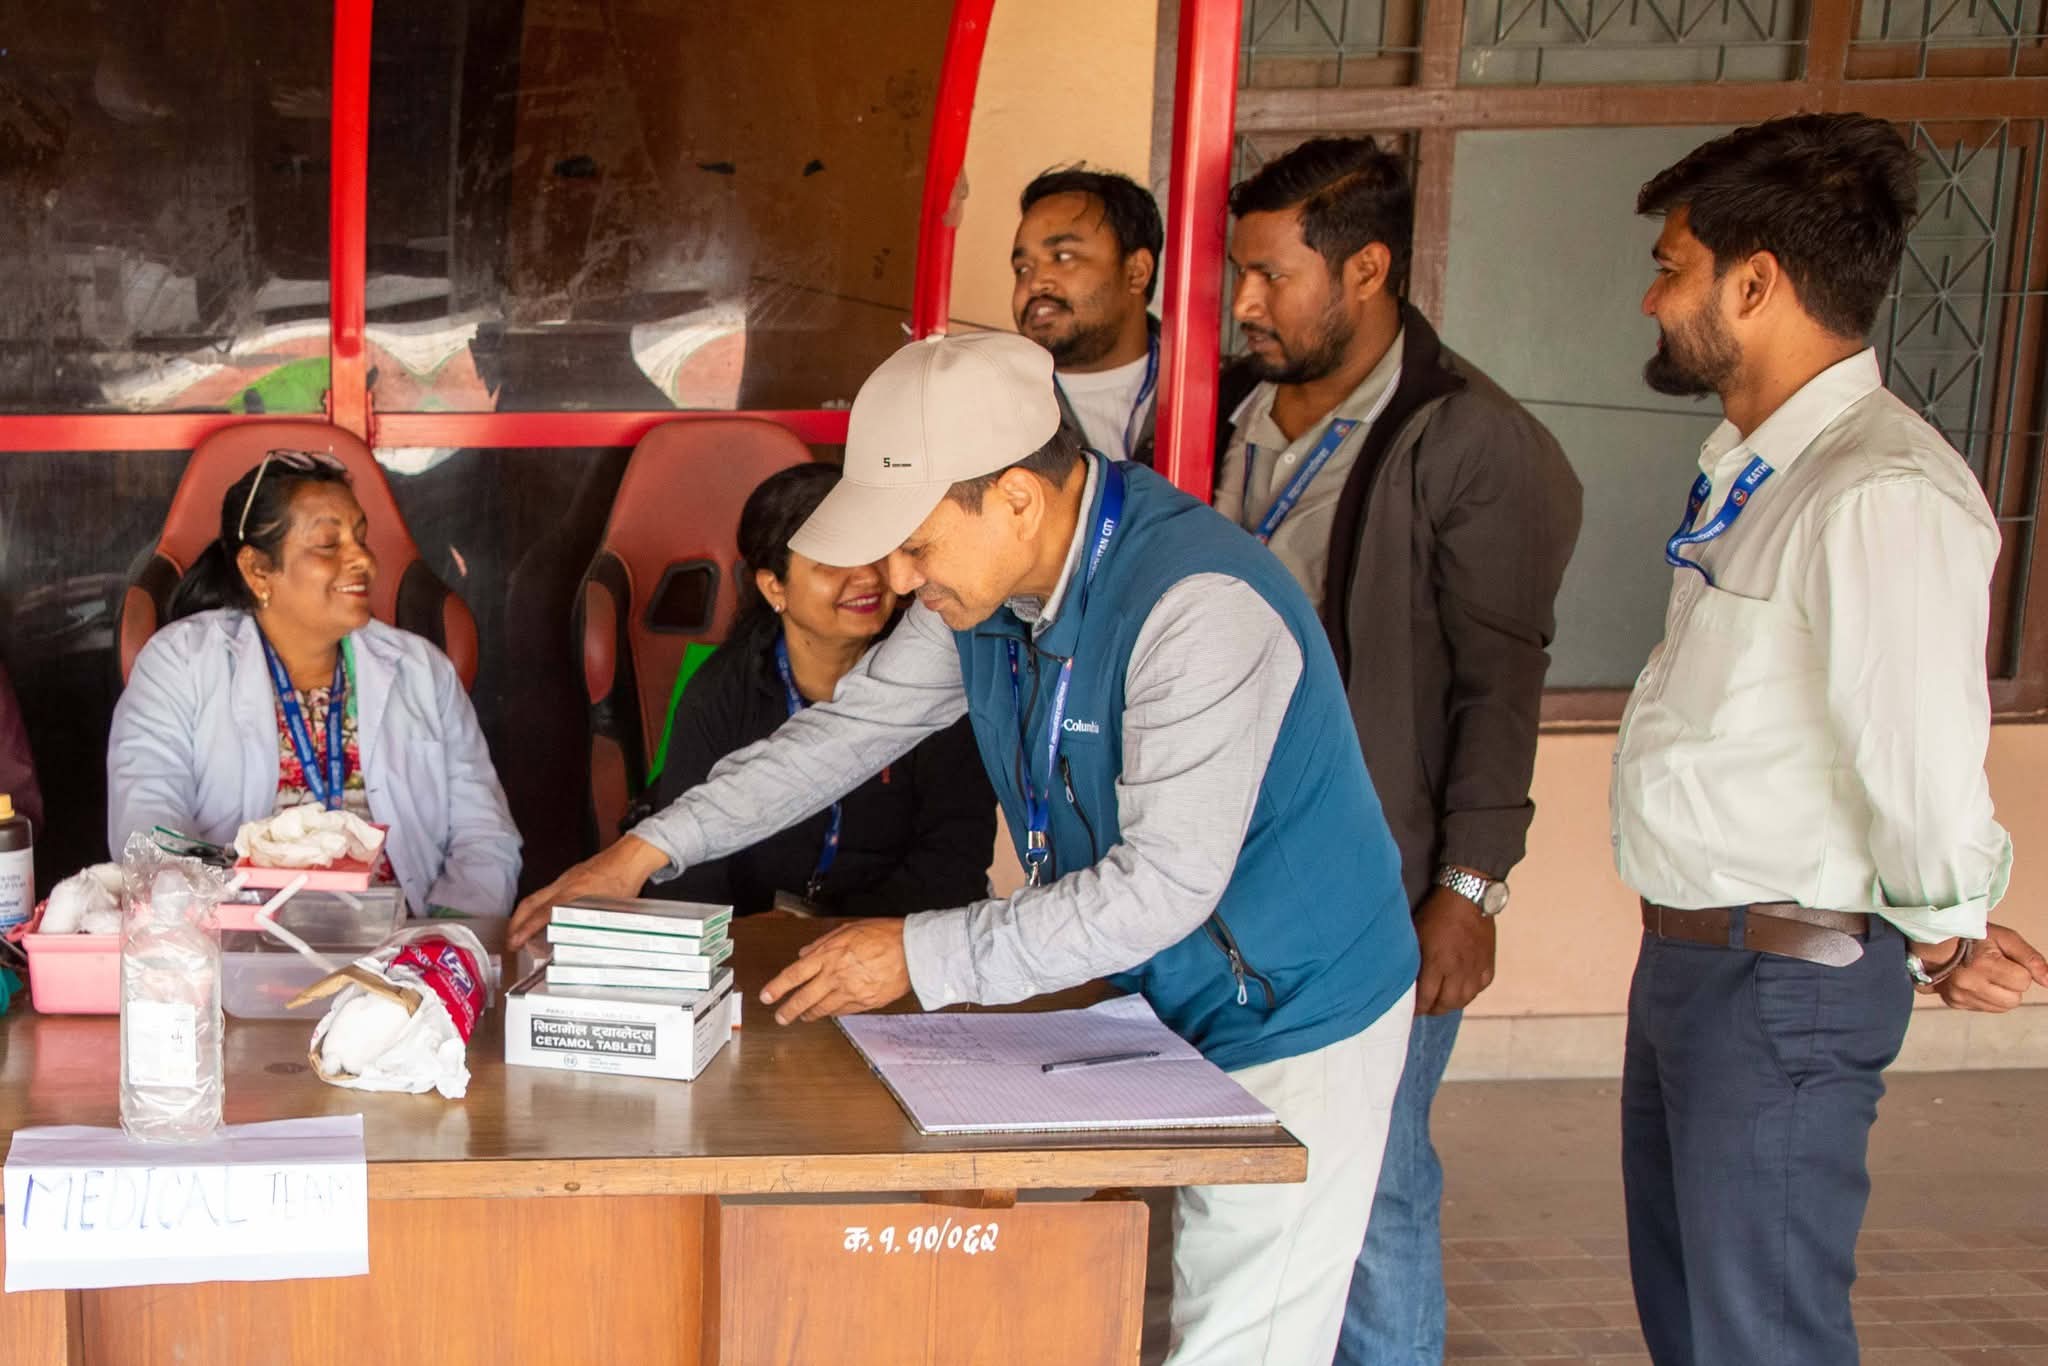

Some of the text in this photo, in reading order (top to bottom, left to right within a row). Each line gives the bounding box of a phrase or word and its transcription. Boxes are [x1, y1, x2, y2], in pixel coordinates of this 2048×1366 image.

[1102, 517, 1115, 536] CITY
[535, 1035, 652, 1054] CETAMOL TABLETS
[22, 1165, 248, 1230] MEDICAL
